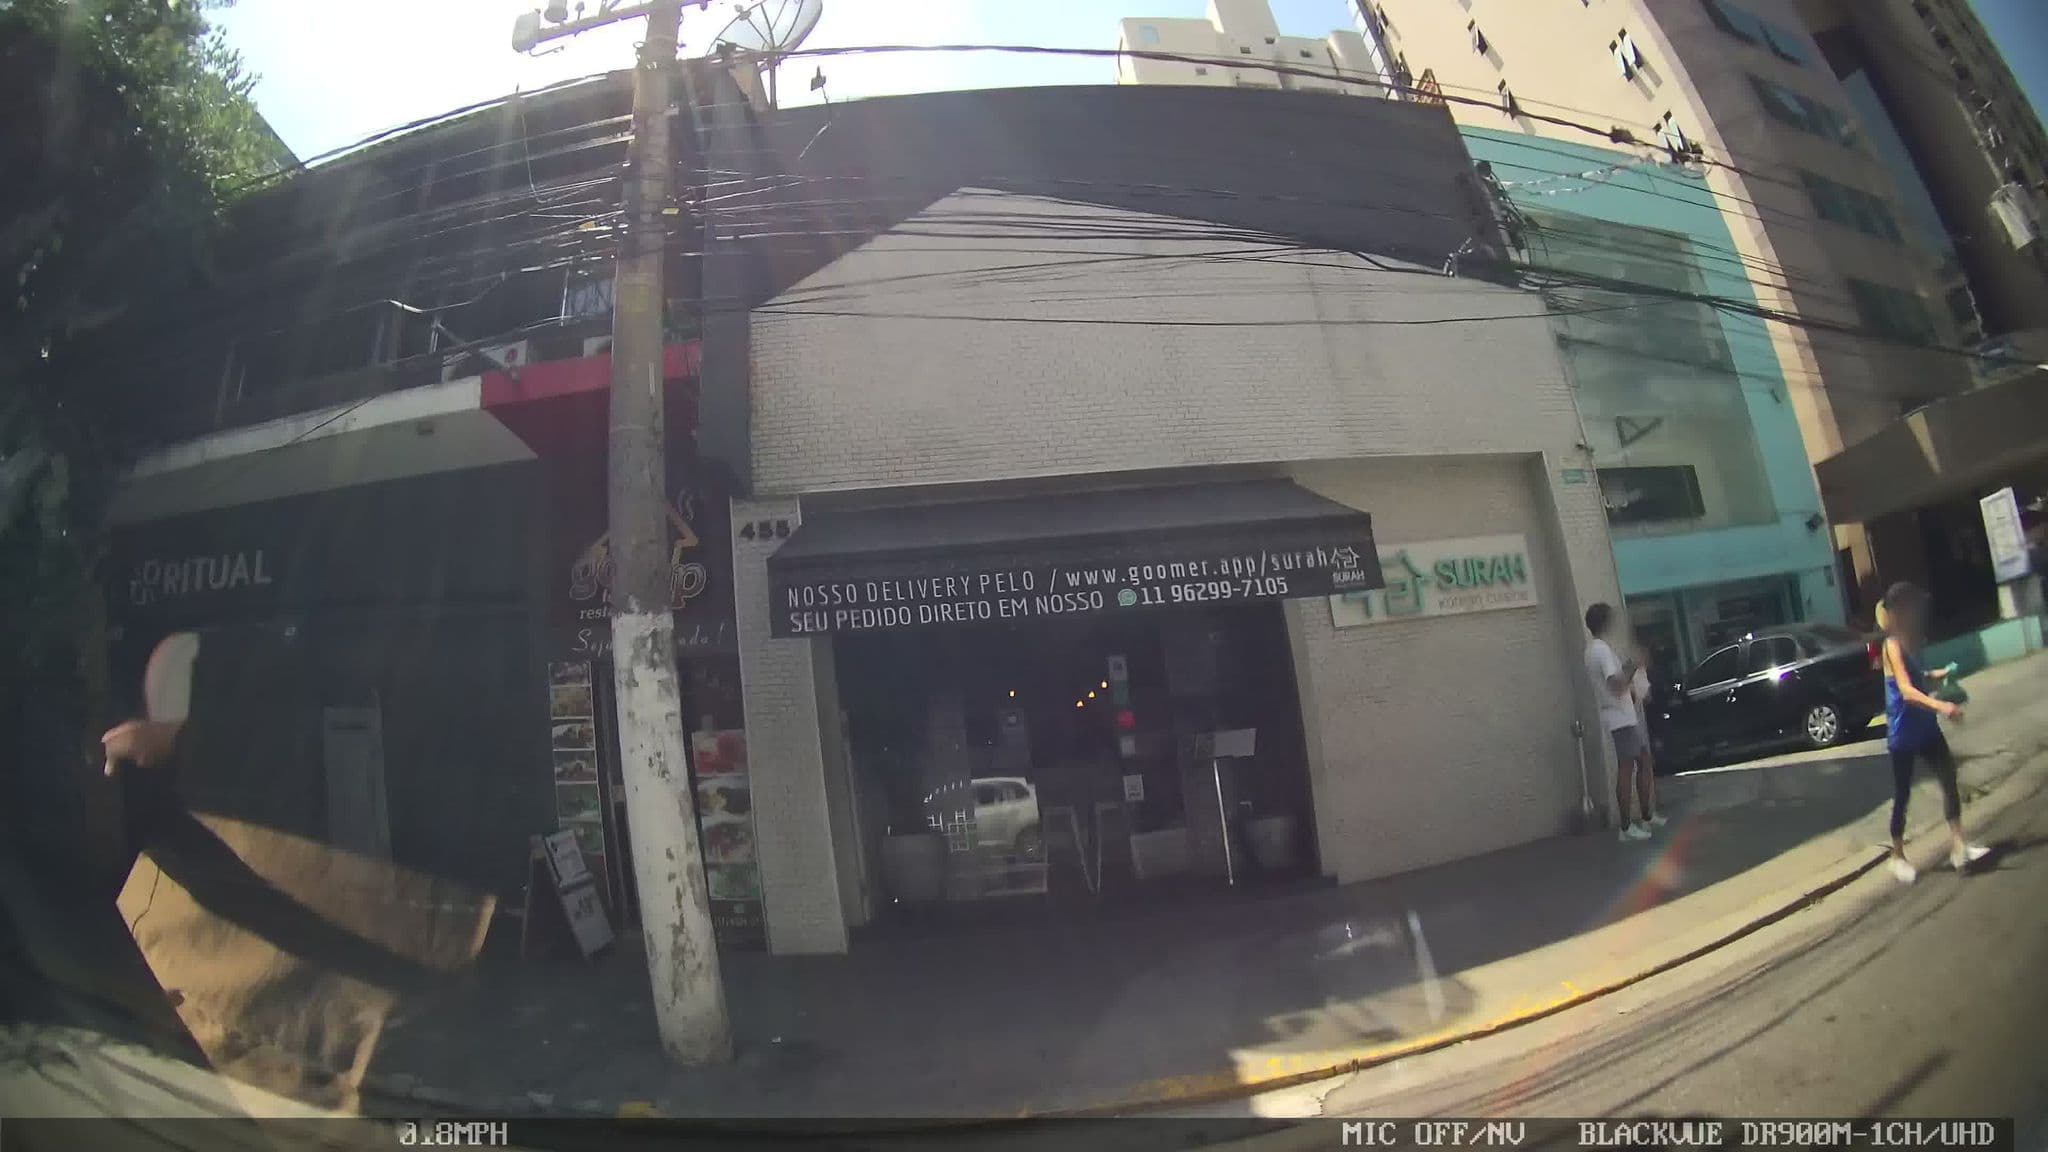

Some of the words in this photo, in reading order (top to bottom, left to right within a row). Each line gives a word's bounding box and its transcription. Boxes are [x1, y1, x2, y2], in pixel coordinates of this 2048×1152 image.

[162, 549, 273, 594] RITUAL
[787, 583, 858, 608] NOSSO
[866, 574, 971, 603] DELIVERY
[979, 570, 1036, 594] PELO
[1065, 546, 1329, 588] www.goomer.app/surah
[1332, 569, 1366, 584] SURAH
[1434, 552, 1527, 591] SURAH
[789, 611, 829, 634] SEU
[835, 606, 913, 631] PEDIDO
[919, 599, 992, 625] DIRETO
[998, 597, 1029, 619] EM
[1035, 590, 1104, 616] NOSSO
[1141, 586, 1166, 606] 11
[1170, 576, 1290, 603] 96299-7105
